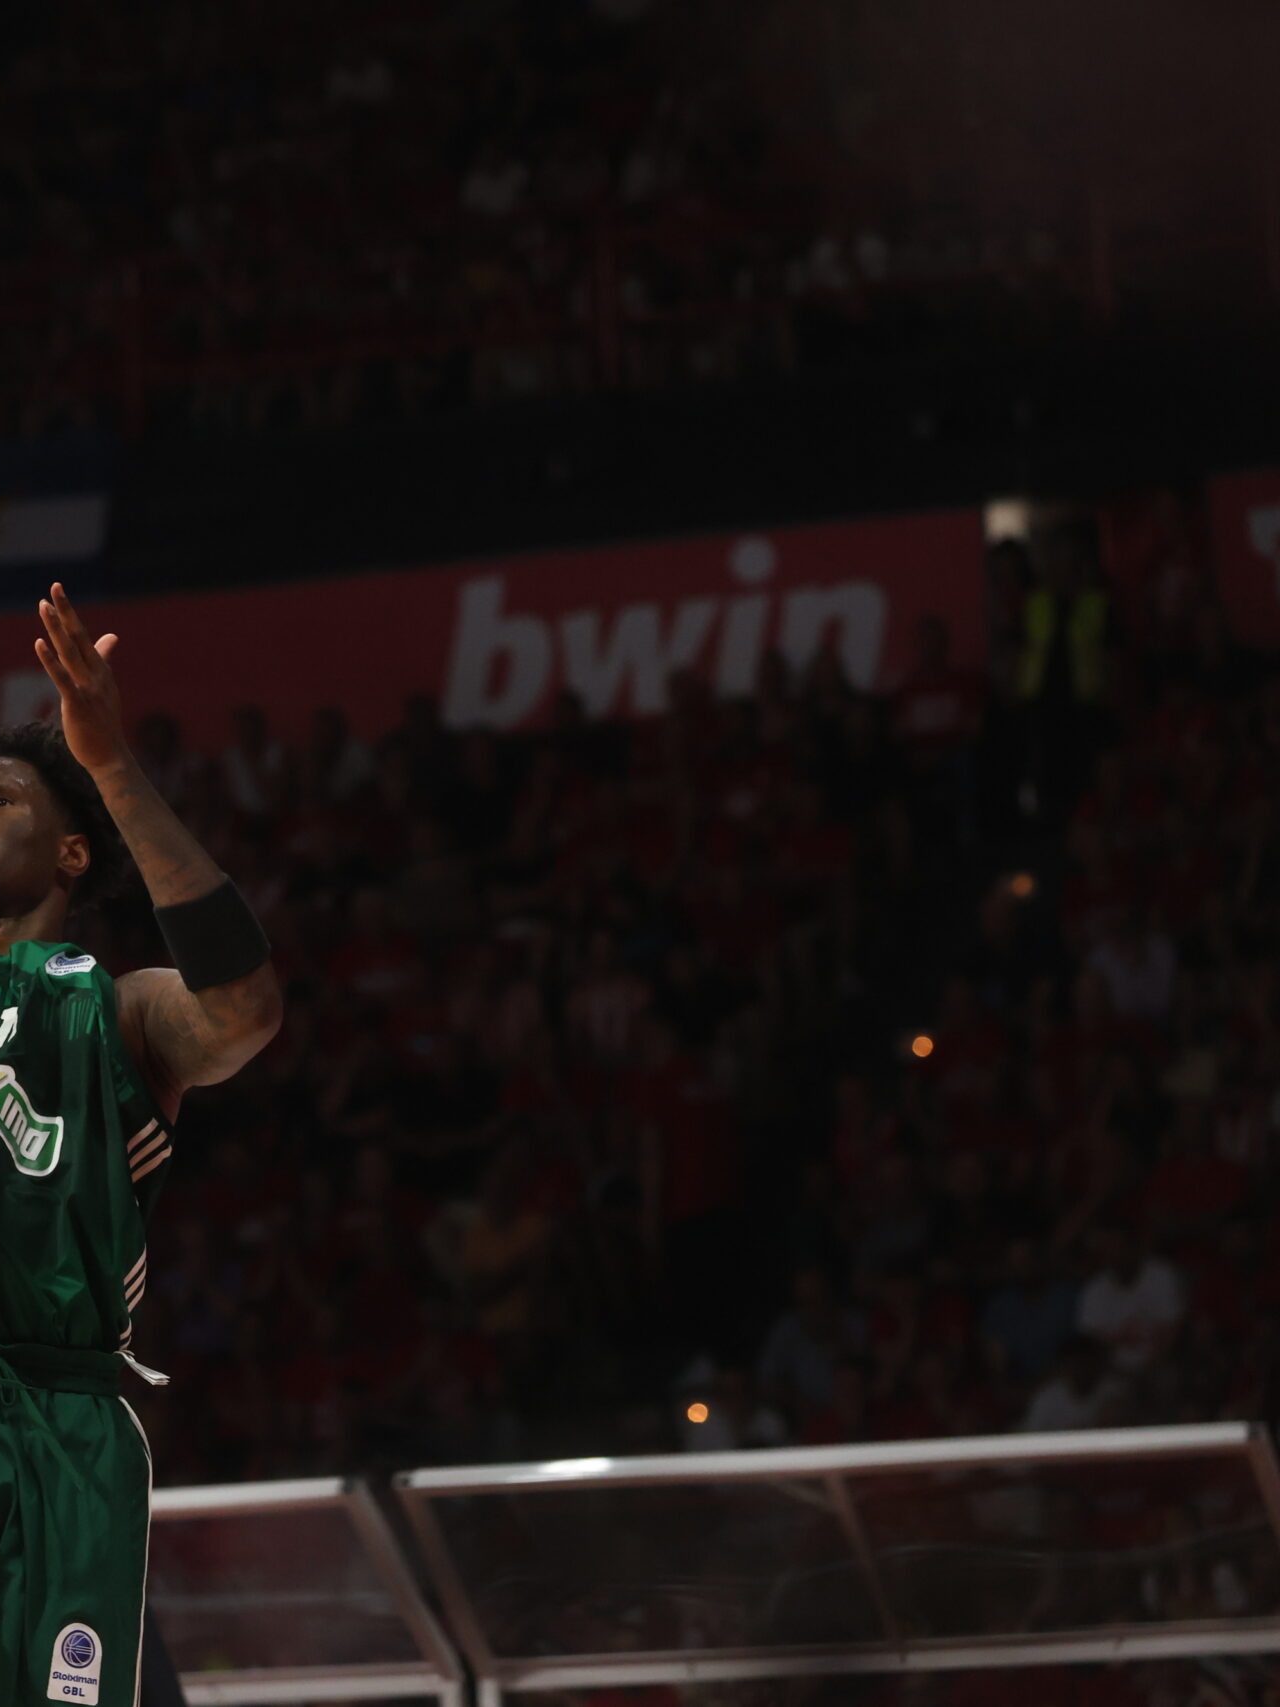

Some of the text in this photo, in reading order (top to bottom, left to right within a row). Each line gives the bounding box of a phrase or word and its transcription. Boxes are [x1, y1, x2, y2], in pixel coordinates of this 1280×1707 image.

[438, 535, 892, 732] bwin
[52, 1671, 98, 1686] Stoiximan
[62, 1685, 86, 1697] GBL
